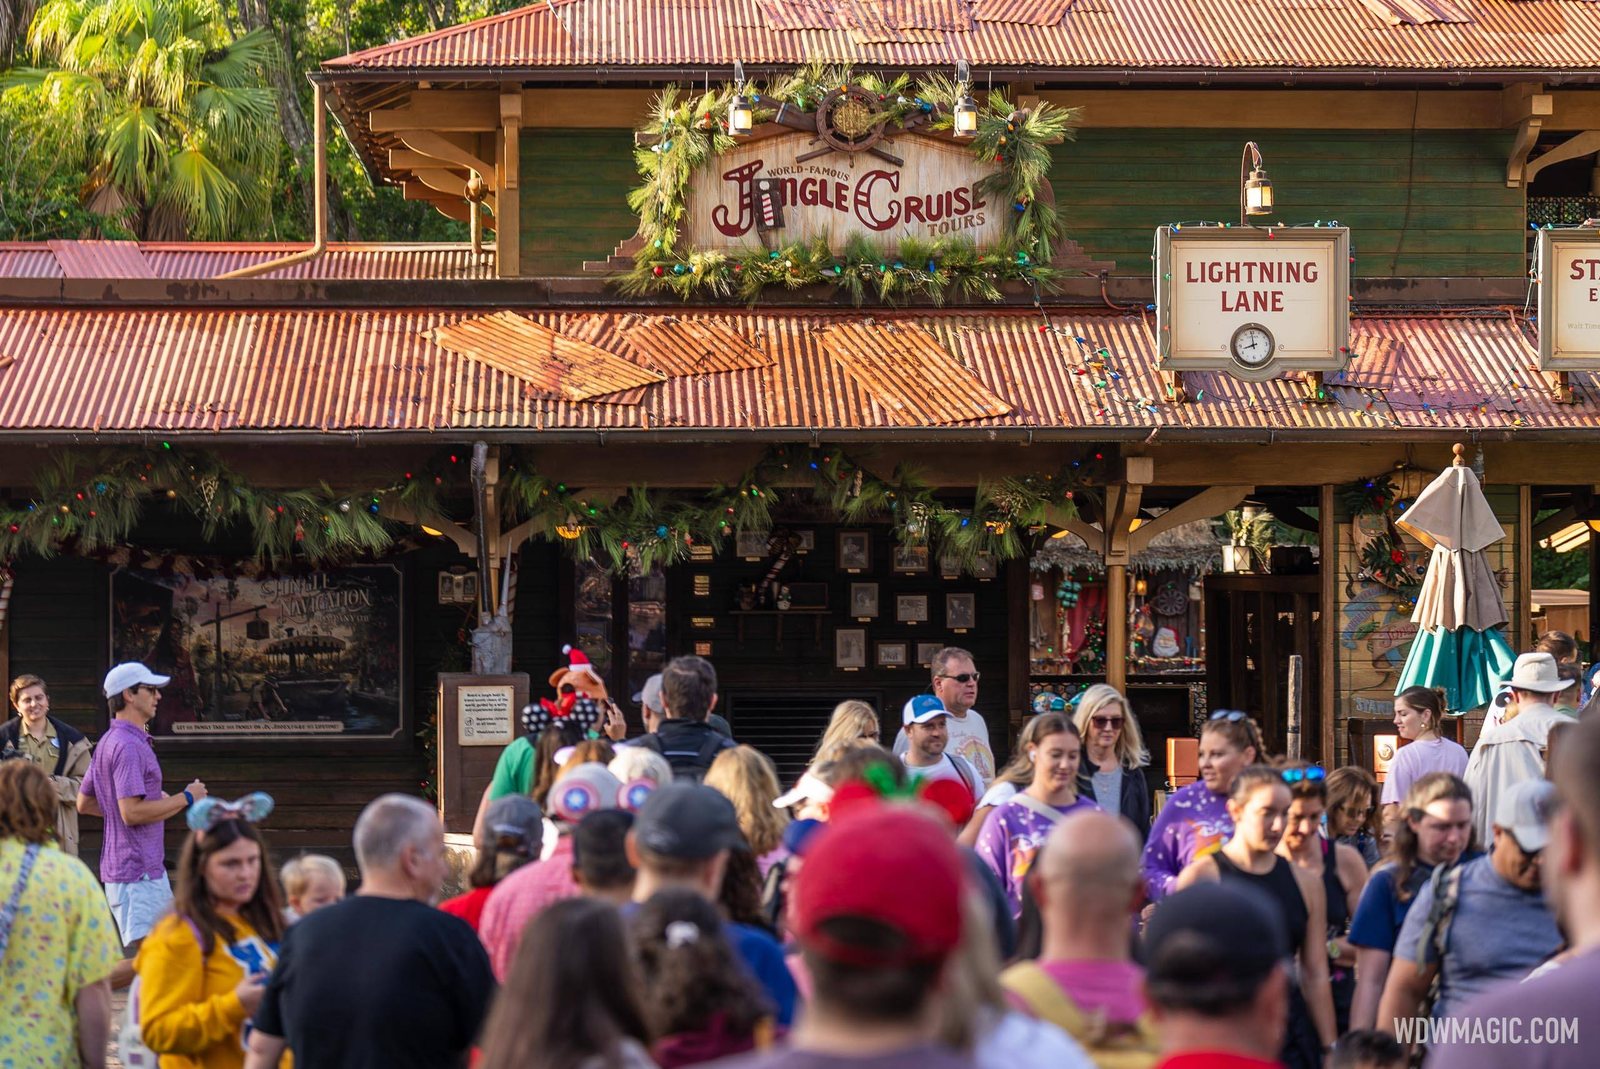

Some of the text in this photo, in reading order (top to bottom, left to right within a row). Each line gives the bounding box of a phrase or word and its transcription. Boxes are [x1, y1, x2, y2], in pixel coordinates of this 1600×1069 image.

[767, 165, 850, 181] WORLD-FAMOUS
[853, 169, 987, 231] CRUISE
[927, 212, 986, 237] TOURS
[1186, 261, 1319, 284] LIGHTNING
[1570, 259, 1600, 280] ST
[1221, 290, 1284, 312] LANE
